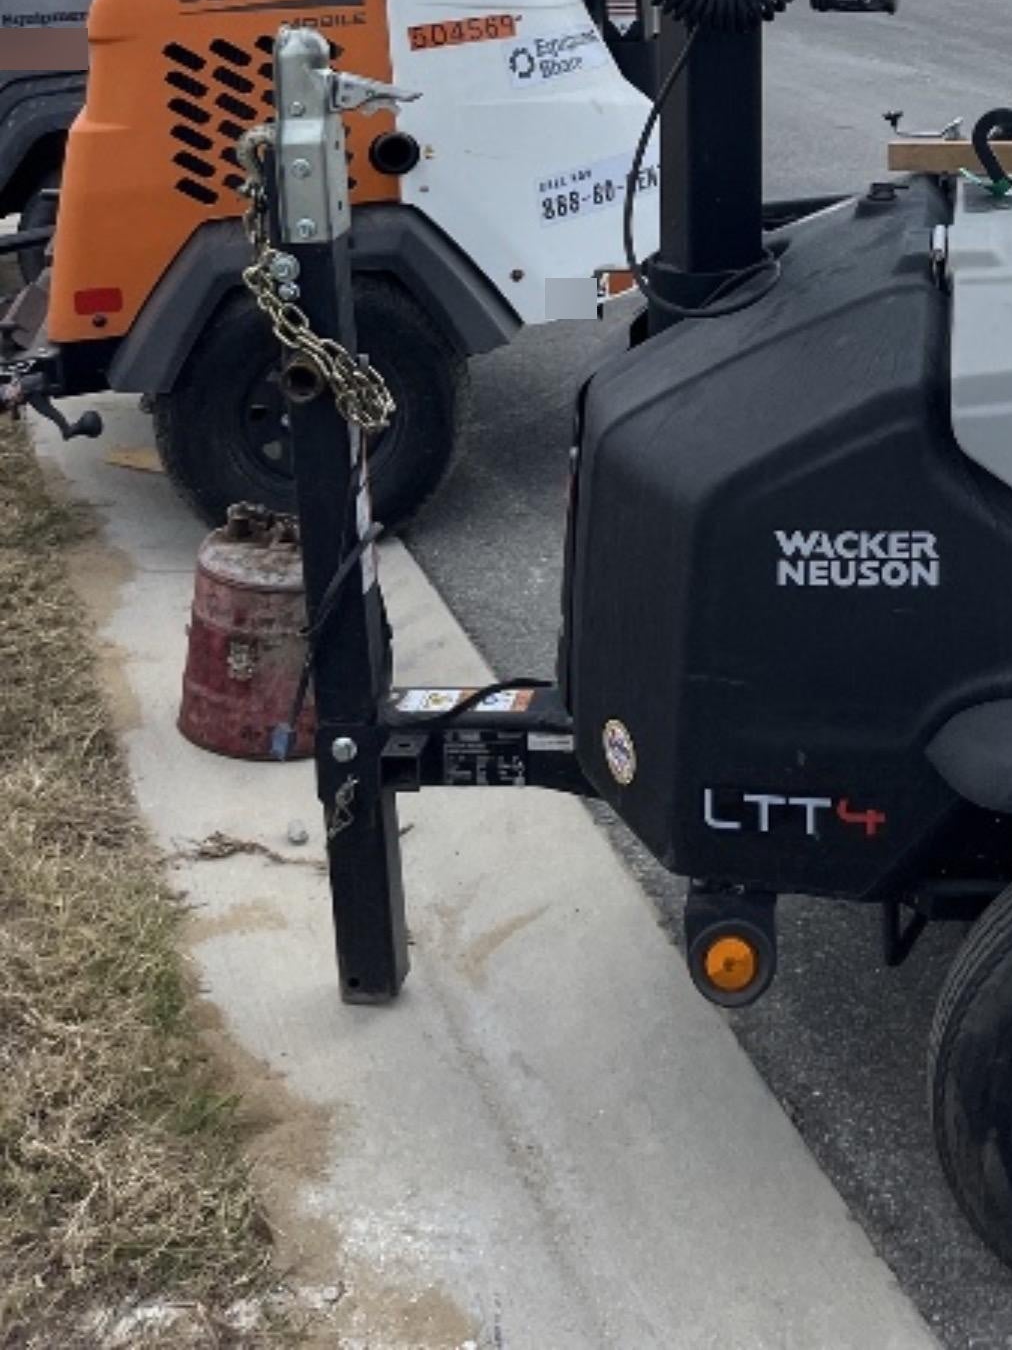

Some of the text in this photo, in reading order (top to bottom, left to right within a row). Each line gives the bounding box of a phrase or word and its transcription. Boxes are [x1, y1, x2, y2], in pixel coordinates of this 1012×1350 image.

[774, 529, 940, 559] WACKER
[776, 559, 940, 587] NEUSON
[704, 788, 887, 836] LTT4
